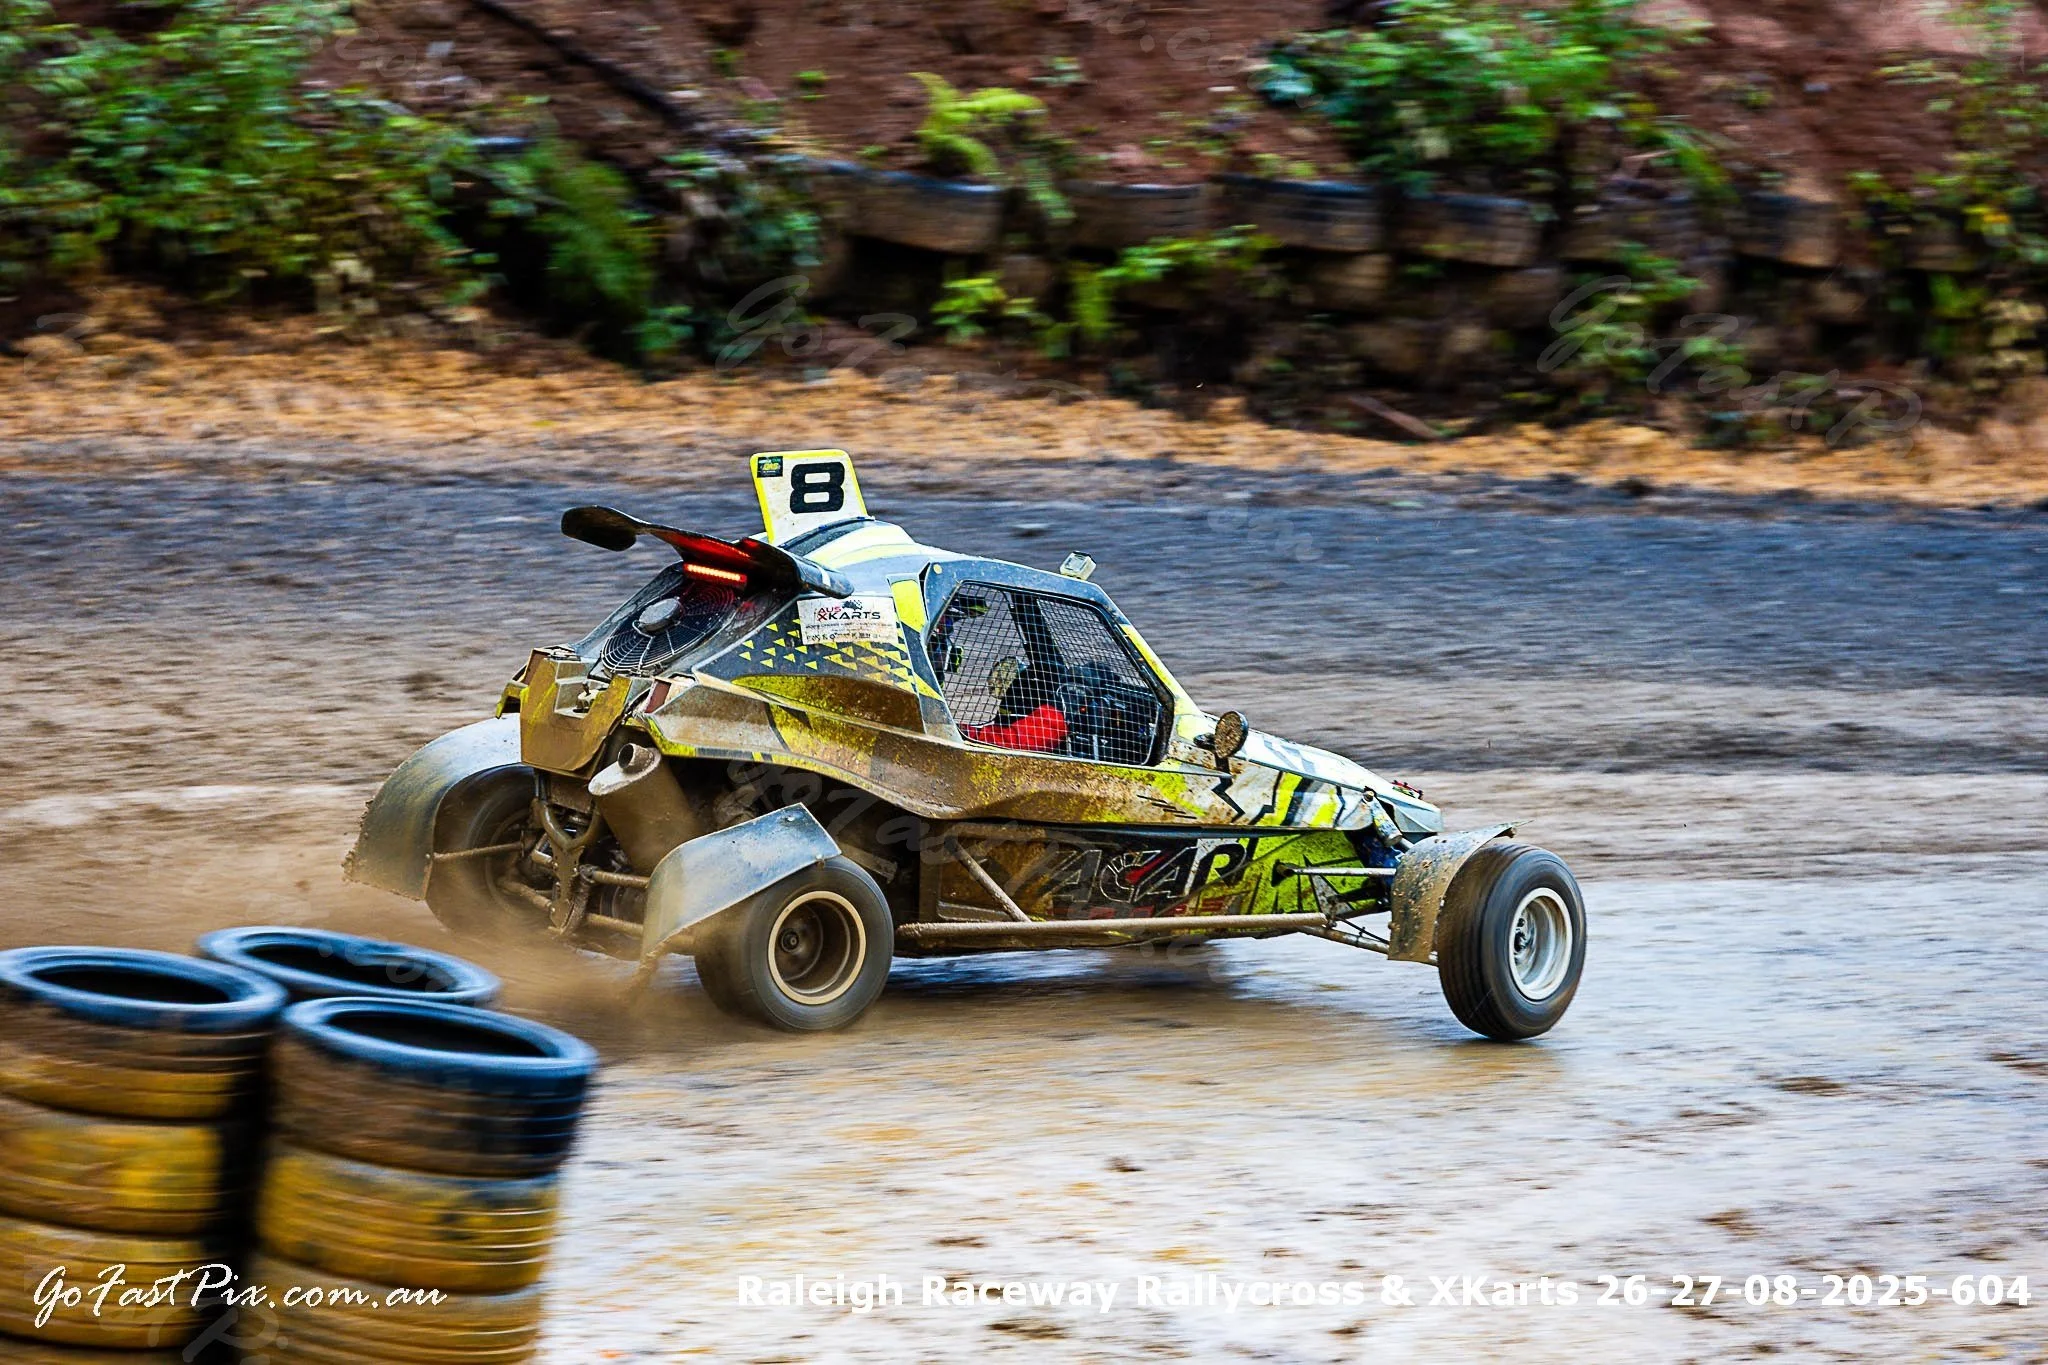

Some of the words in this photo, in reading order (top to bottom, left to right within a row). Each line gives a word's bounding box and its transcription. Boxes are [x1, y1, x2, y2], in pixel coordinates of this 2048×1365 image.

[790, 461, 845, 514] 8
[818, 606, 842, 614] AUS
[817, 611, 881, 622] XKARTS
